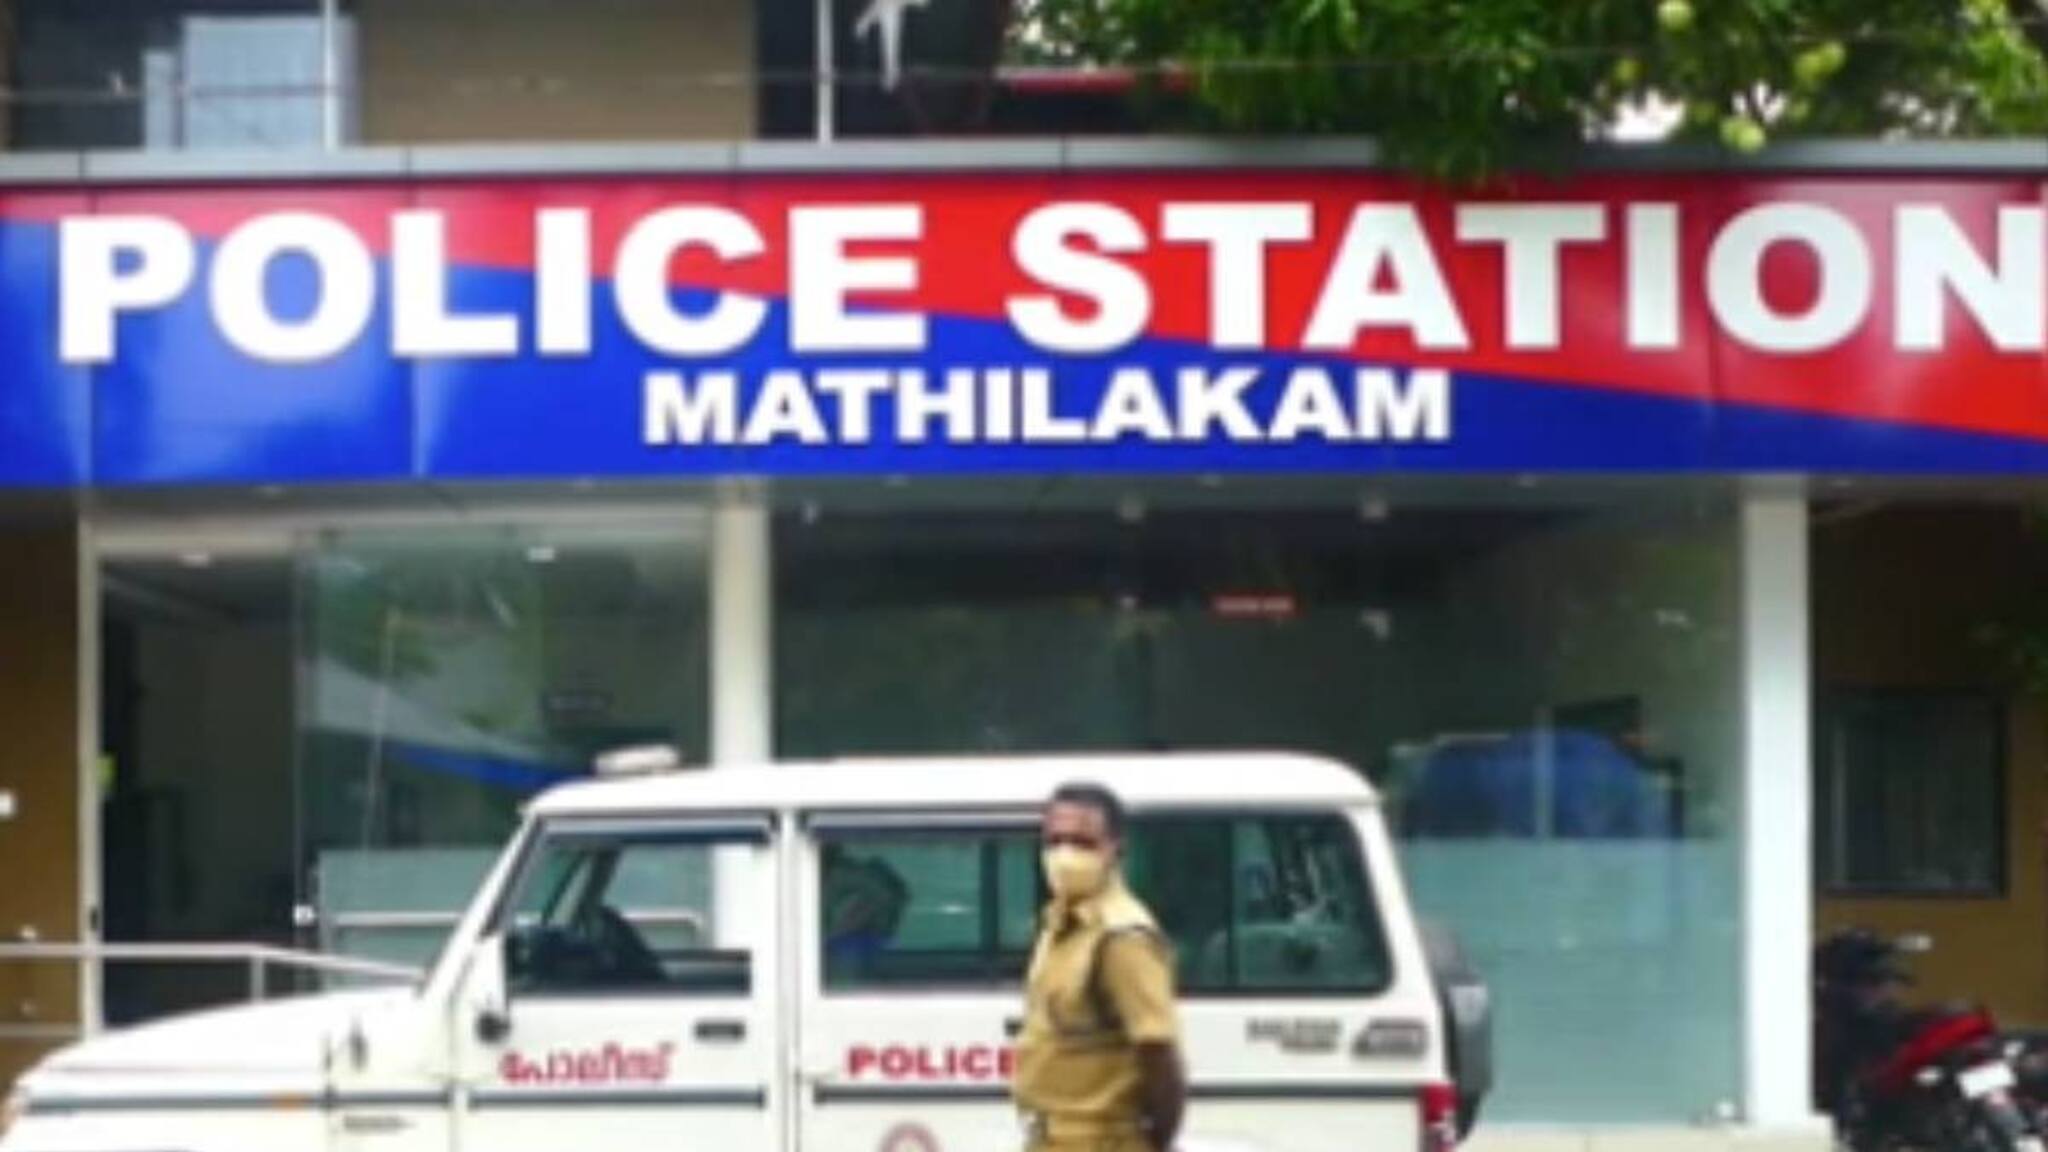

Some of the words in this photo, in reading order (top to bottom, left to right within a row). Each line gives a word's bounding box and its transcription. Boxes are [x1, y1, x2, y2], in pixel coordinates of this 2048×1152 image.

[57, 202, 928, 362] POLICE
[1006, 202, 2046, 354] STATION
[643, 367, 1450, 444] MATHILAKAM
